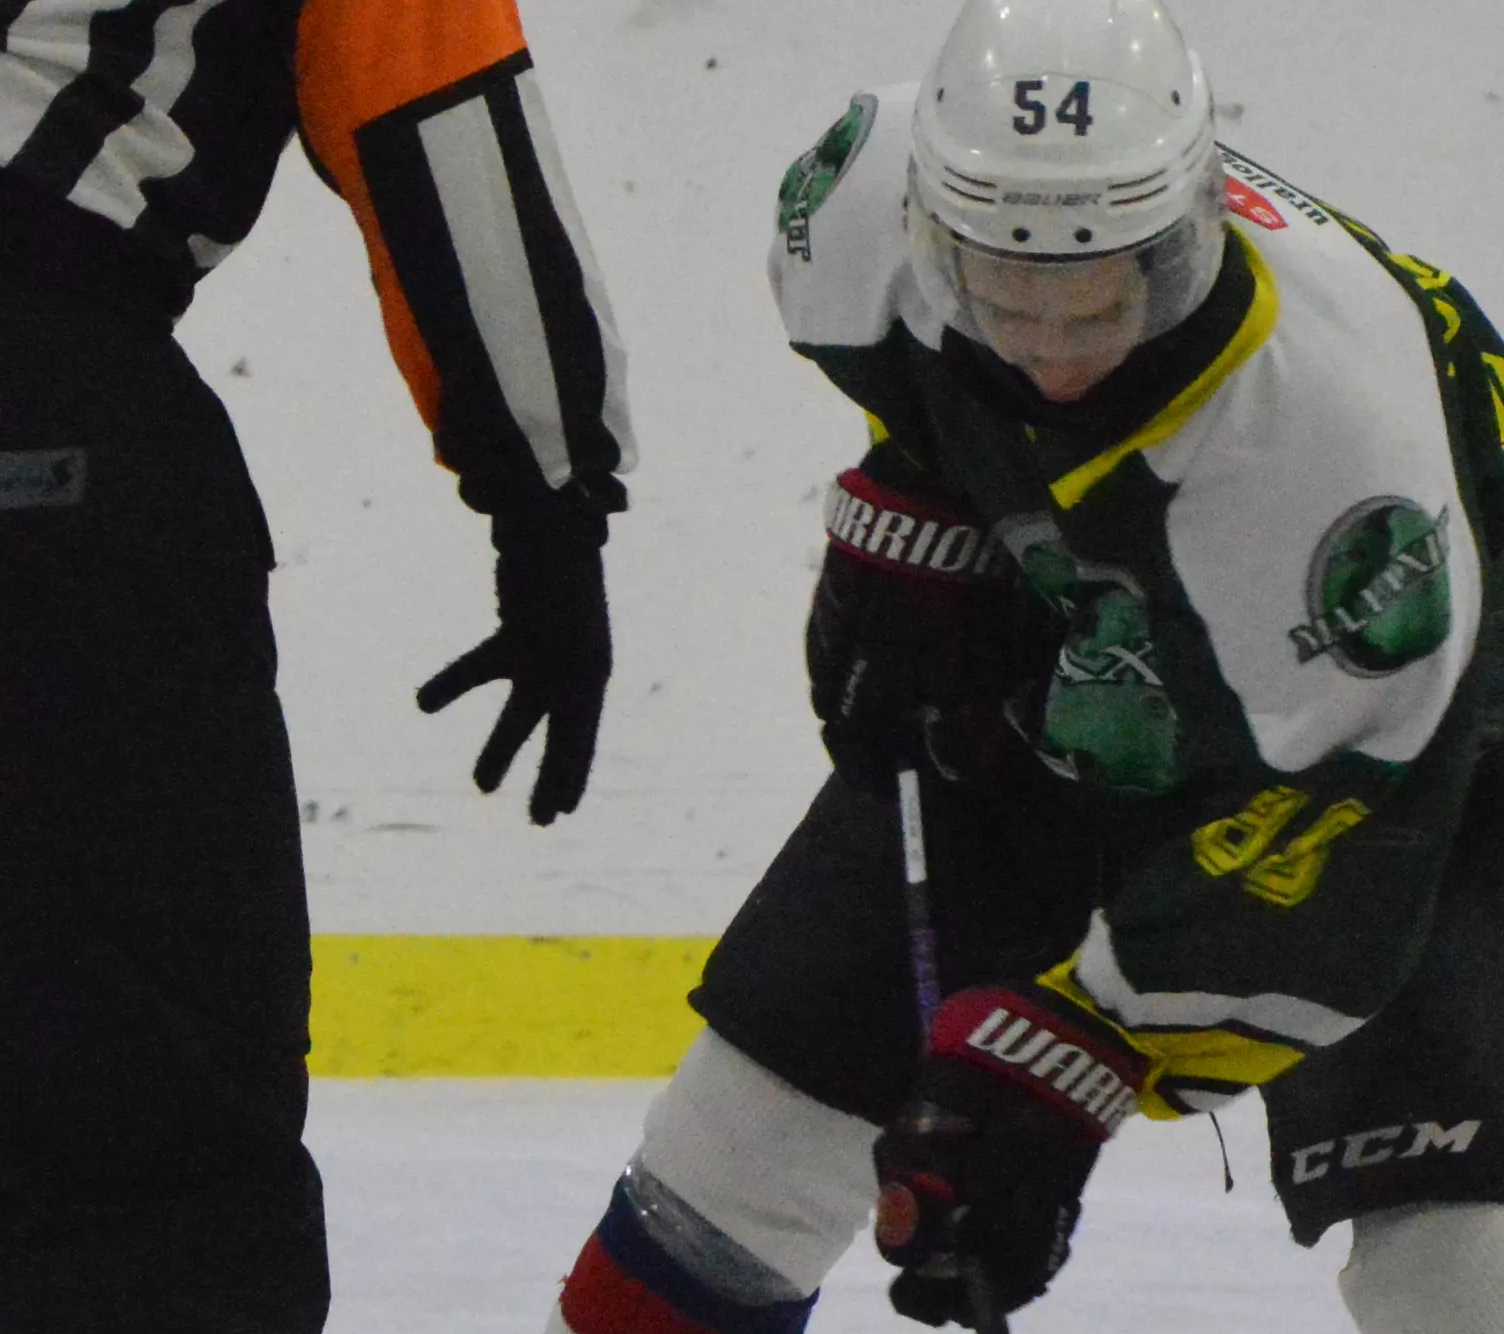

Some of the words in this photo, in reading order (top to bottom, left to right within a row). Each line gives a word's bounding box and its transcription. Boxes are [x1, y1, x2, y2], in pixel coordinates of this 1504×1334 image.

[1012, 79, 1094, 137] 54
[966, 1007, 1138, 1134] WARR
[1289, 1119, 1485, 1186] CCM
